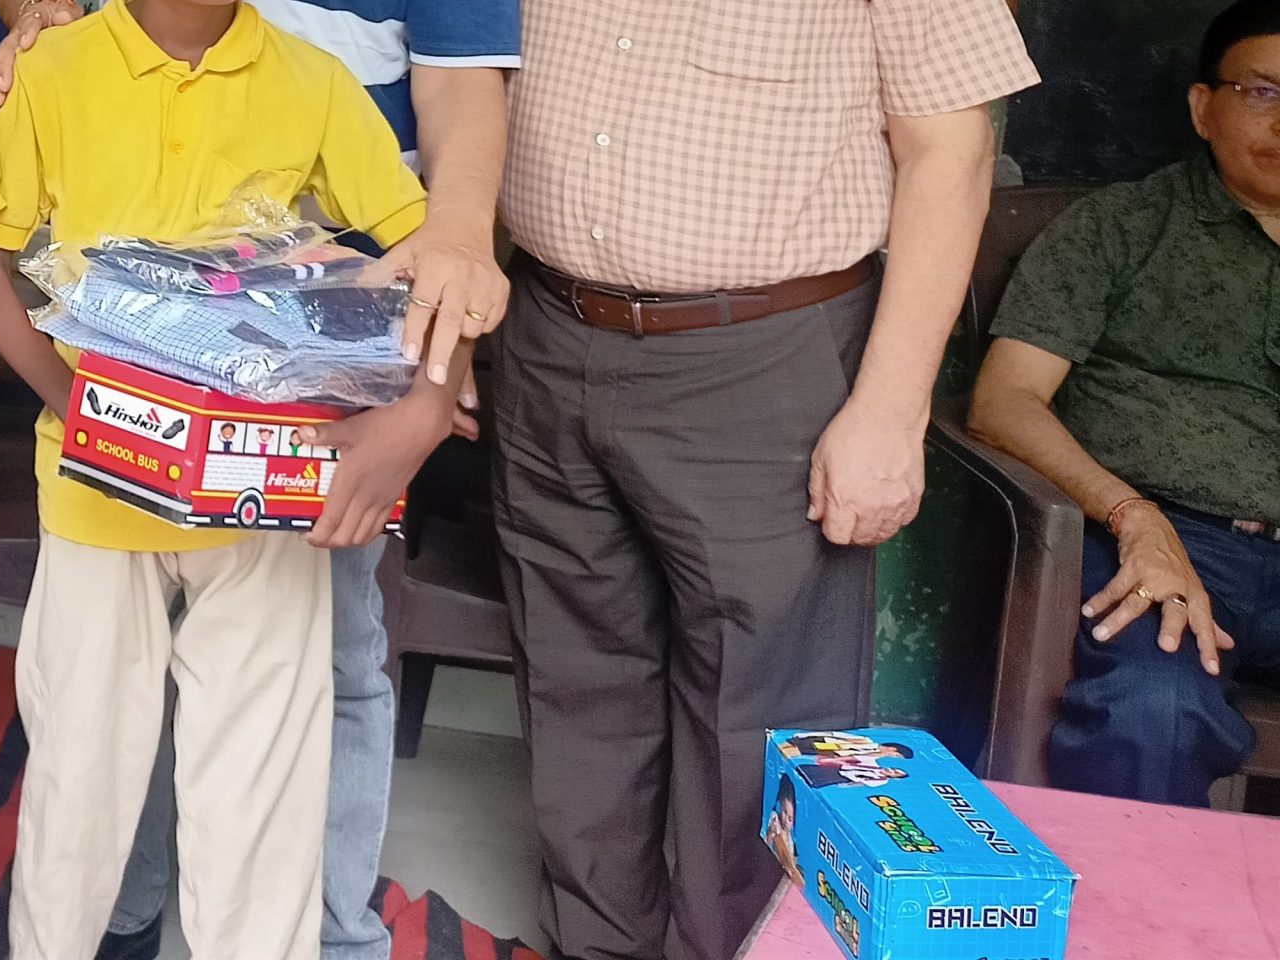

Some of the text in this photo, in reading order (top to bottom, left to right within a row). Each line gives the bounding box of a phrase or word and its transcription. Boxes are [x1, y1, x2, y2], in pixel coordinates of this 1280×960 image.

[96, 438, 159, 472] SCHOOL BUS
[929, 783, 1020, 856] BALENO
[817, 827, 870, 915] BALENO
[926, 906, 1038, 929] BALENO
